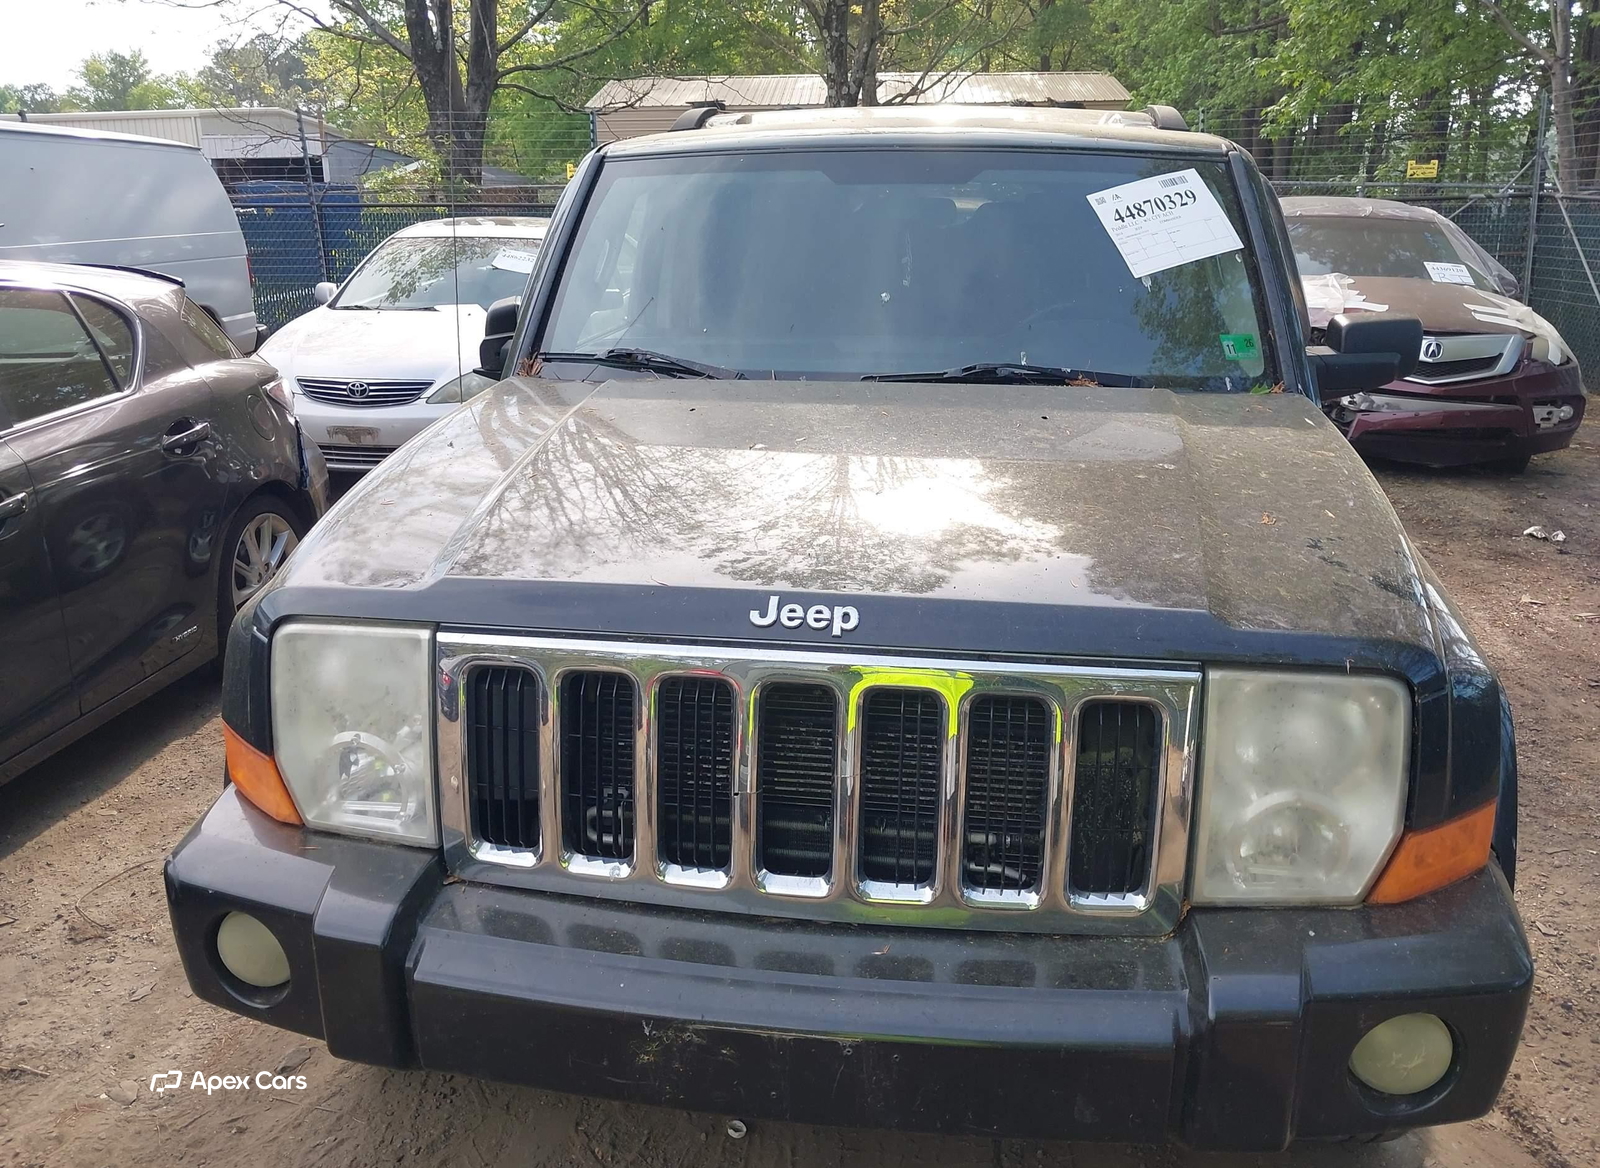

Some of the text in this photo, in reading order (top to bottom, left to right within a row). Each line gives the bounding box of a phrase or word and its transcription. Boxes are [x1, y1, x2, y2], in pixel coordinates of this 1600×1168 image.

[1114, 190, 1197, 222] 44870329
[1226, 344, 1237, 355] 11
[1243, 338, 1255, 348] 26
[749, 595, 860, 638] Jeep
